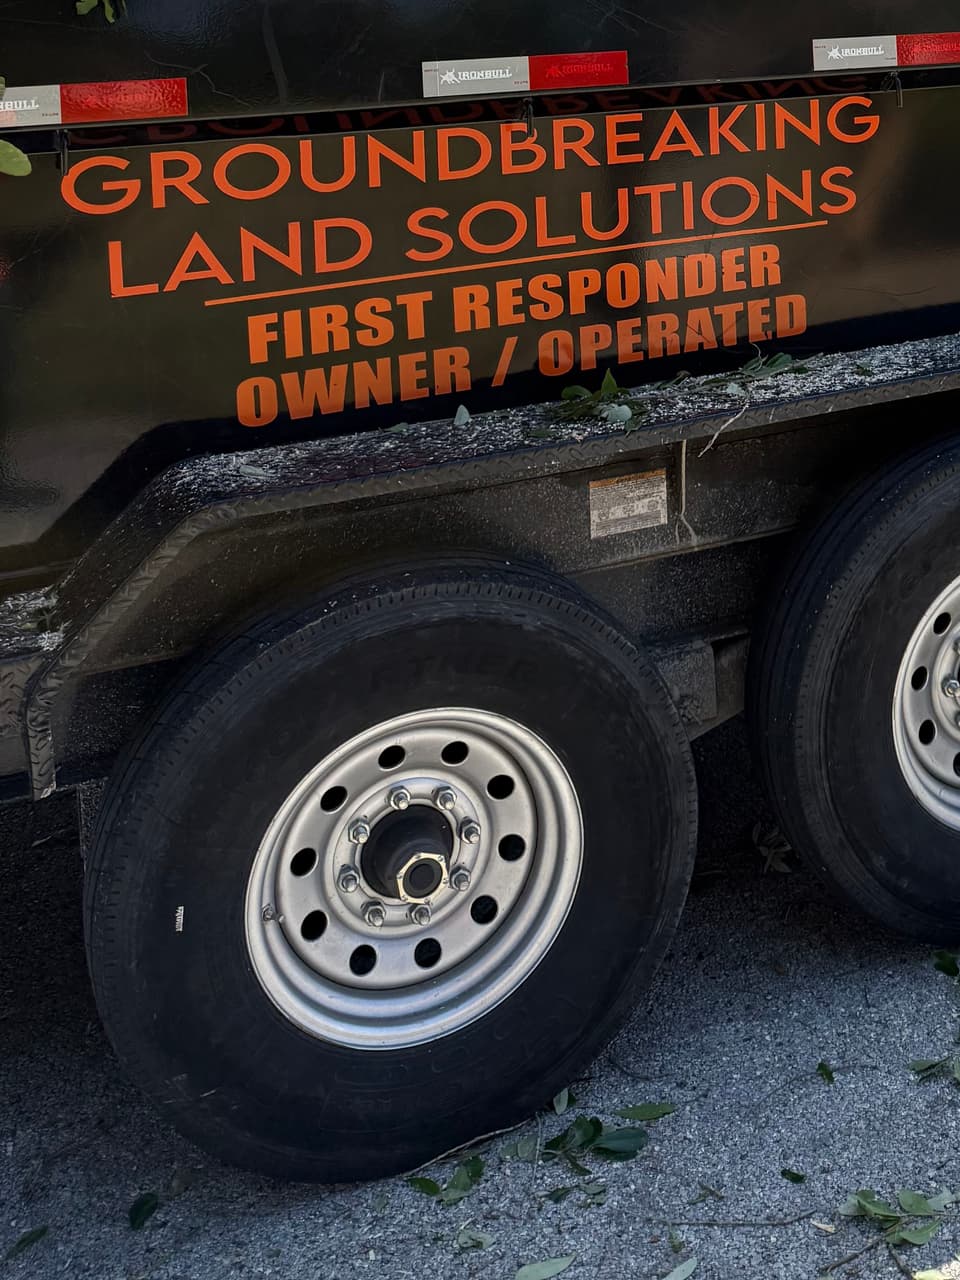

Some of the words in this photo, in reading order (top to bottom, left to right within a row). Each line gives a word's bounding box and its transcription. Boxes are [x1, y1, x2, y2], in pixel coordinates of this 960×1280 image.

[458, 67, 512, 81] IRONBULL
[841, 45, 885, 57] IRONBULL
[60, 96, 880, 214] GROUNDBREAKING
[108, 218, 372, 298] LAND
[405, 166, 856, 261] SOLUTIONS
[237, 347, 470, 426] OWNER
[493, 337, 517, 386] /
[538, 294, 806, 375] OPERATED
[248, 291, 432, 364] FIRST
[453, 244, 781, 332] RESPONDER
